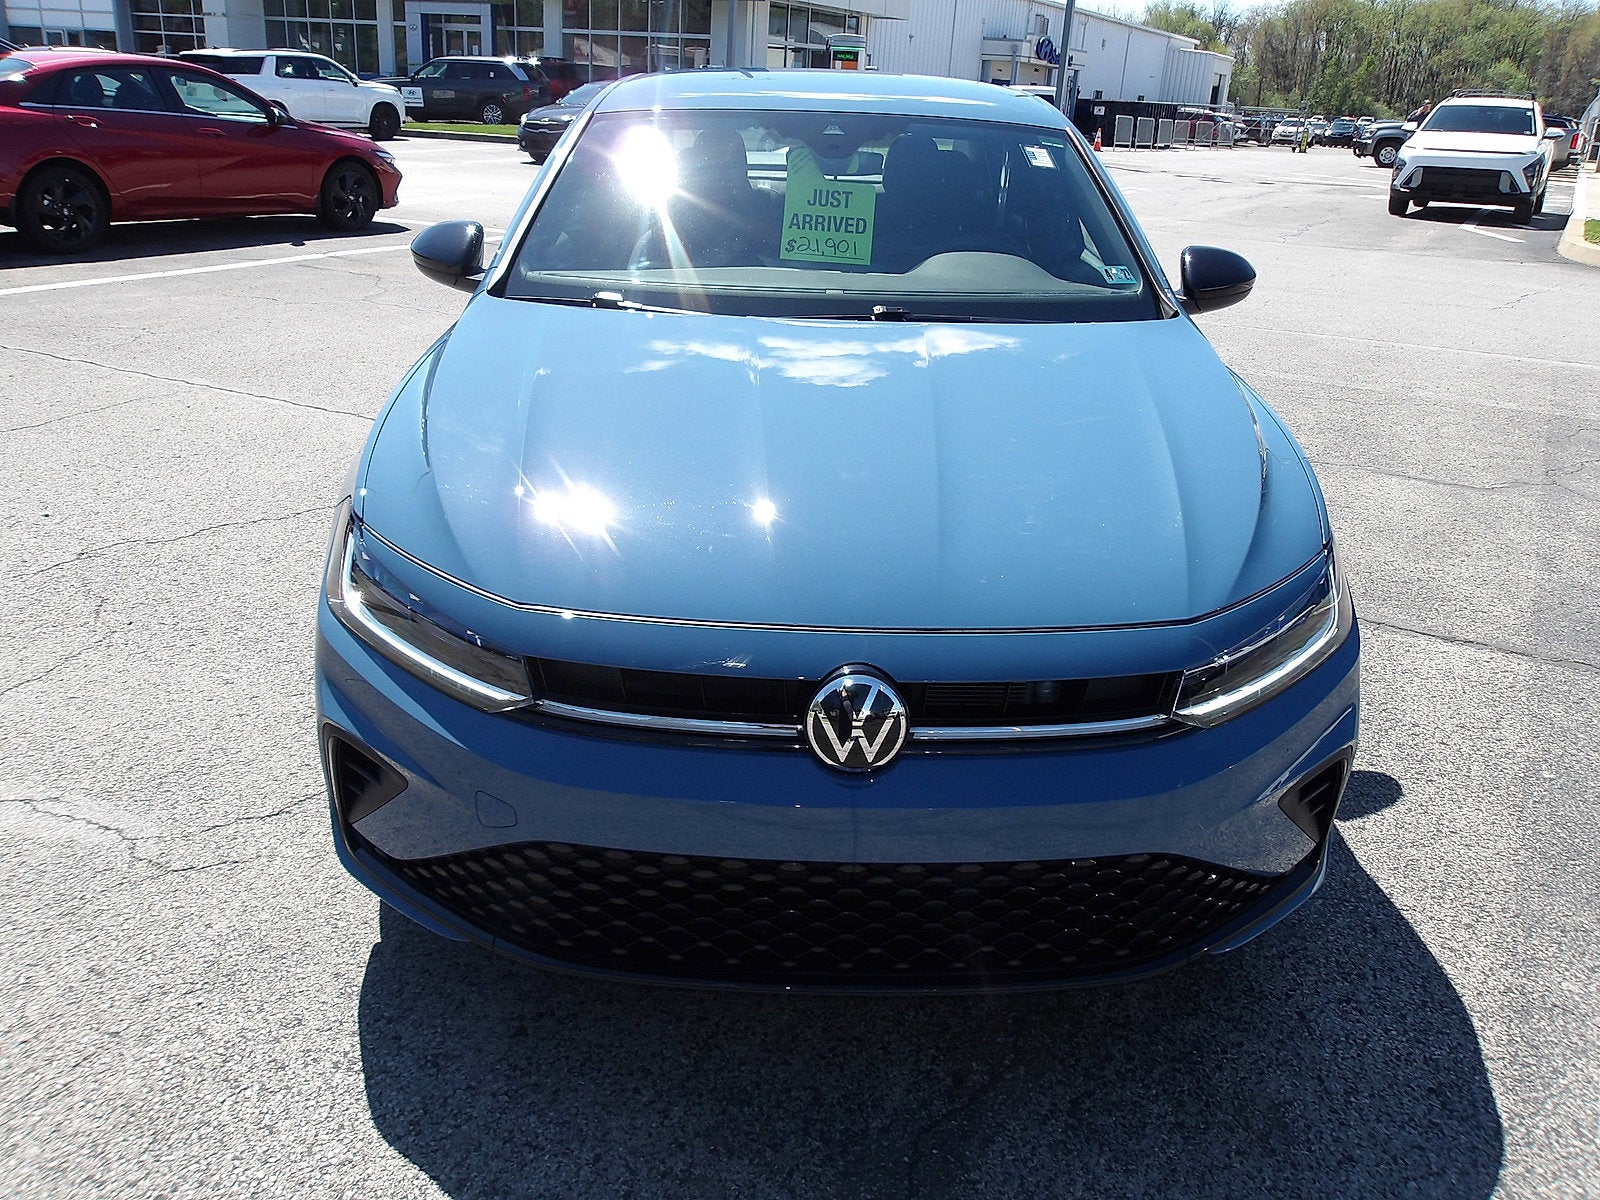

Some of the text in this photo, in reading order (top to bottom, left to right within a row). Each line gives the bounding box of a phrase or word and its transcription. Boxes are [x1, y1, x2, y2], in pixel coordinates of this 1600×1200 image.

[807, 189, 853, 209] JUST
[788, 213, 867, 235] ARRIVED
[785, 236, 857, 256] $21,901
